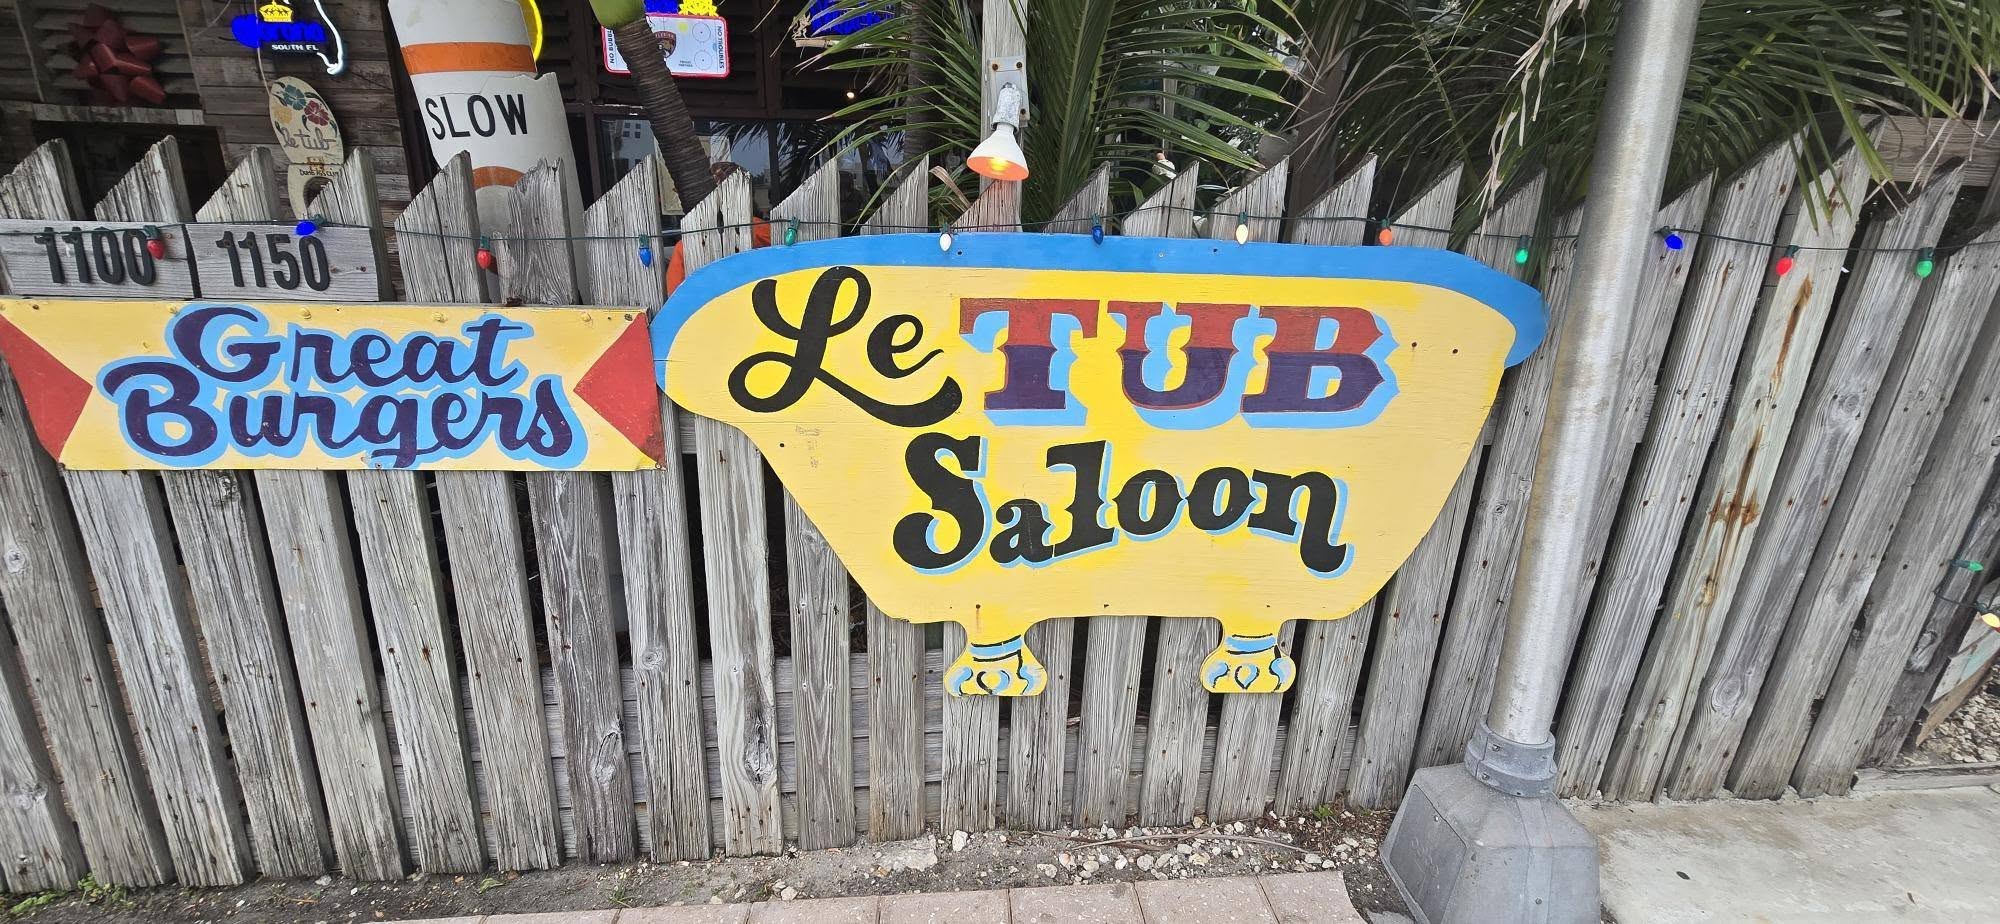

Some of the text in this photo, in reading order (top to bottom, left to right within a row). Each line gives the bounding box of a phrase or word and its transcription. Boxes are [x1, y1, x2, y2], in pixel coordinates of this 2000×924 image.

[609, 53, 615, 64] NO
[717, 26, 724, 37] NO
[424, 93, 528, 140] SLOW
[34, 226, 156, 286] 1100
[215, 230, 331, 292] 1150
[172, 306, 523, 385] Great
[727, 265, 1386, 428] Le TUB
[102, 360, 575, 468] Burgers
[892, 431, 1348, 574] Saloon
